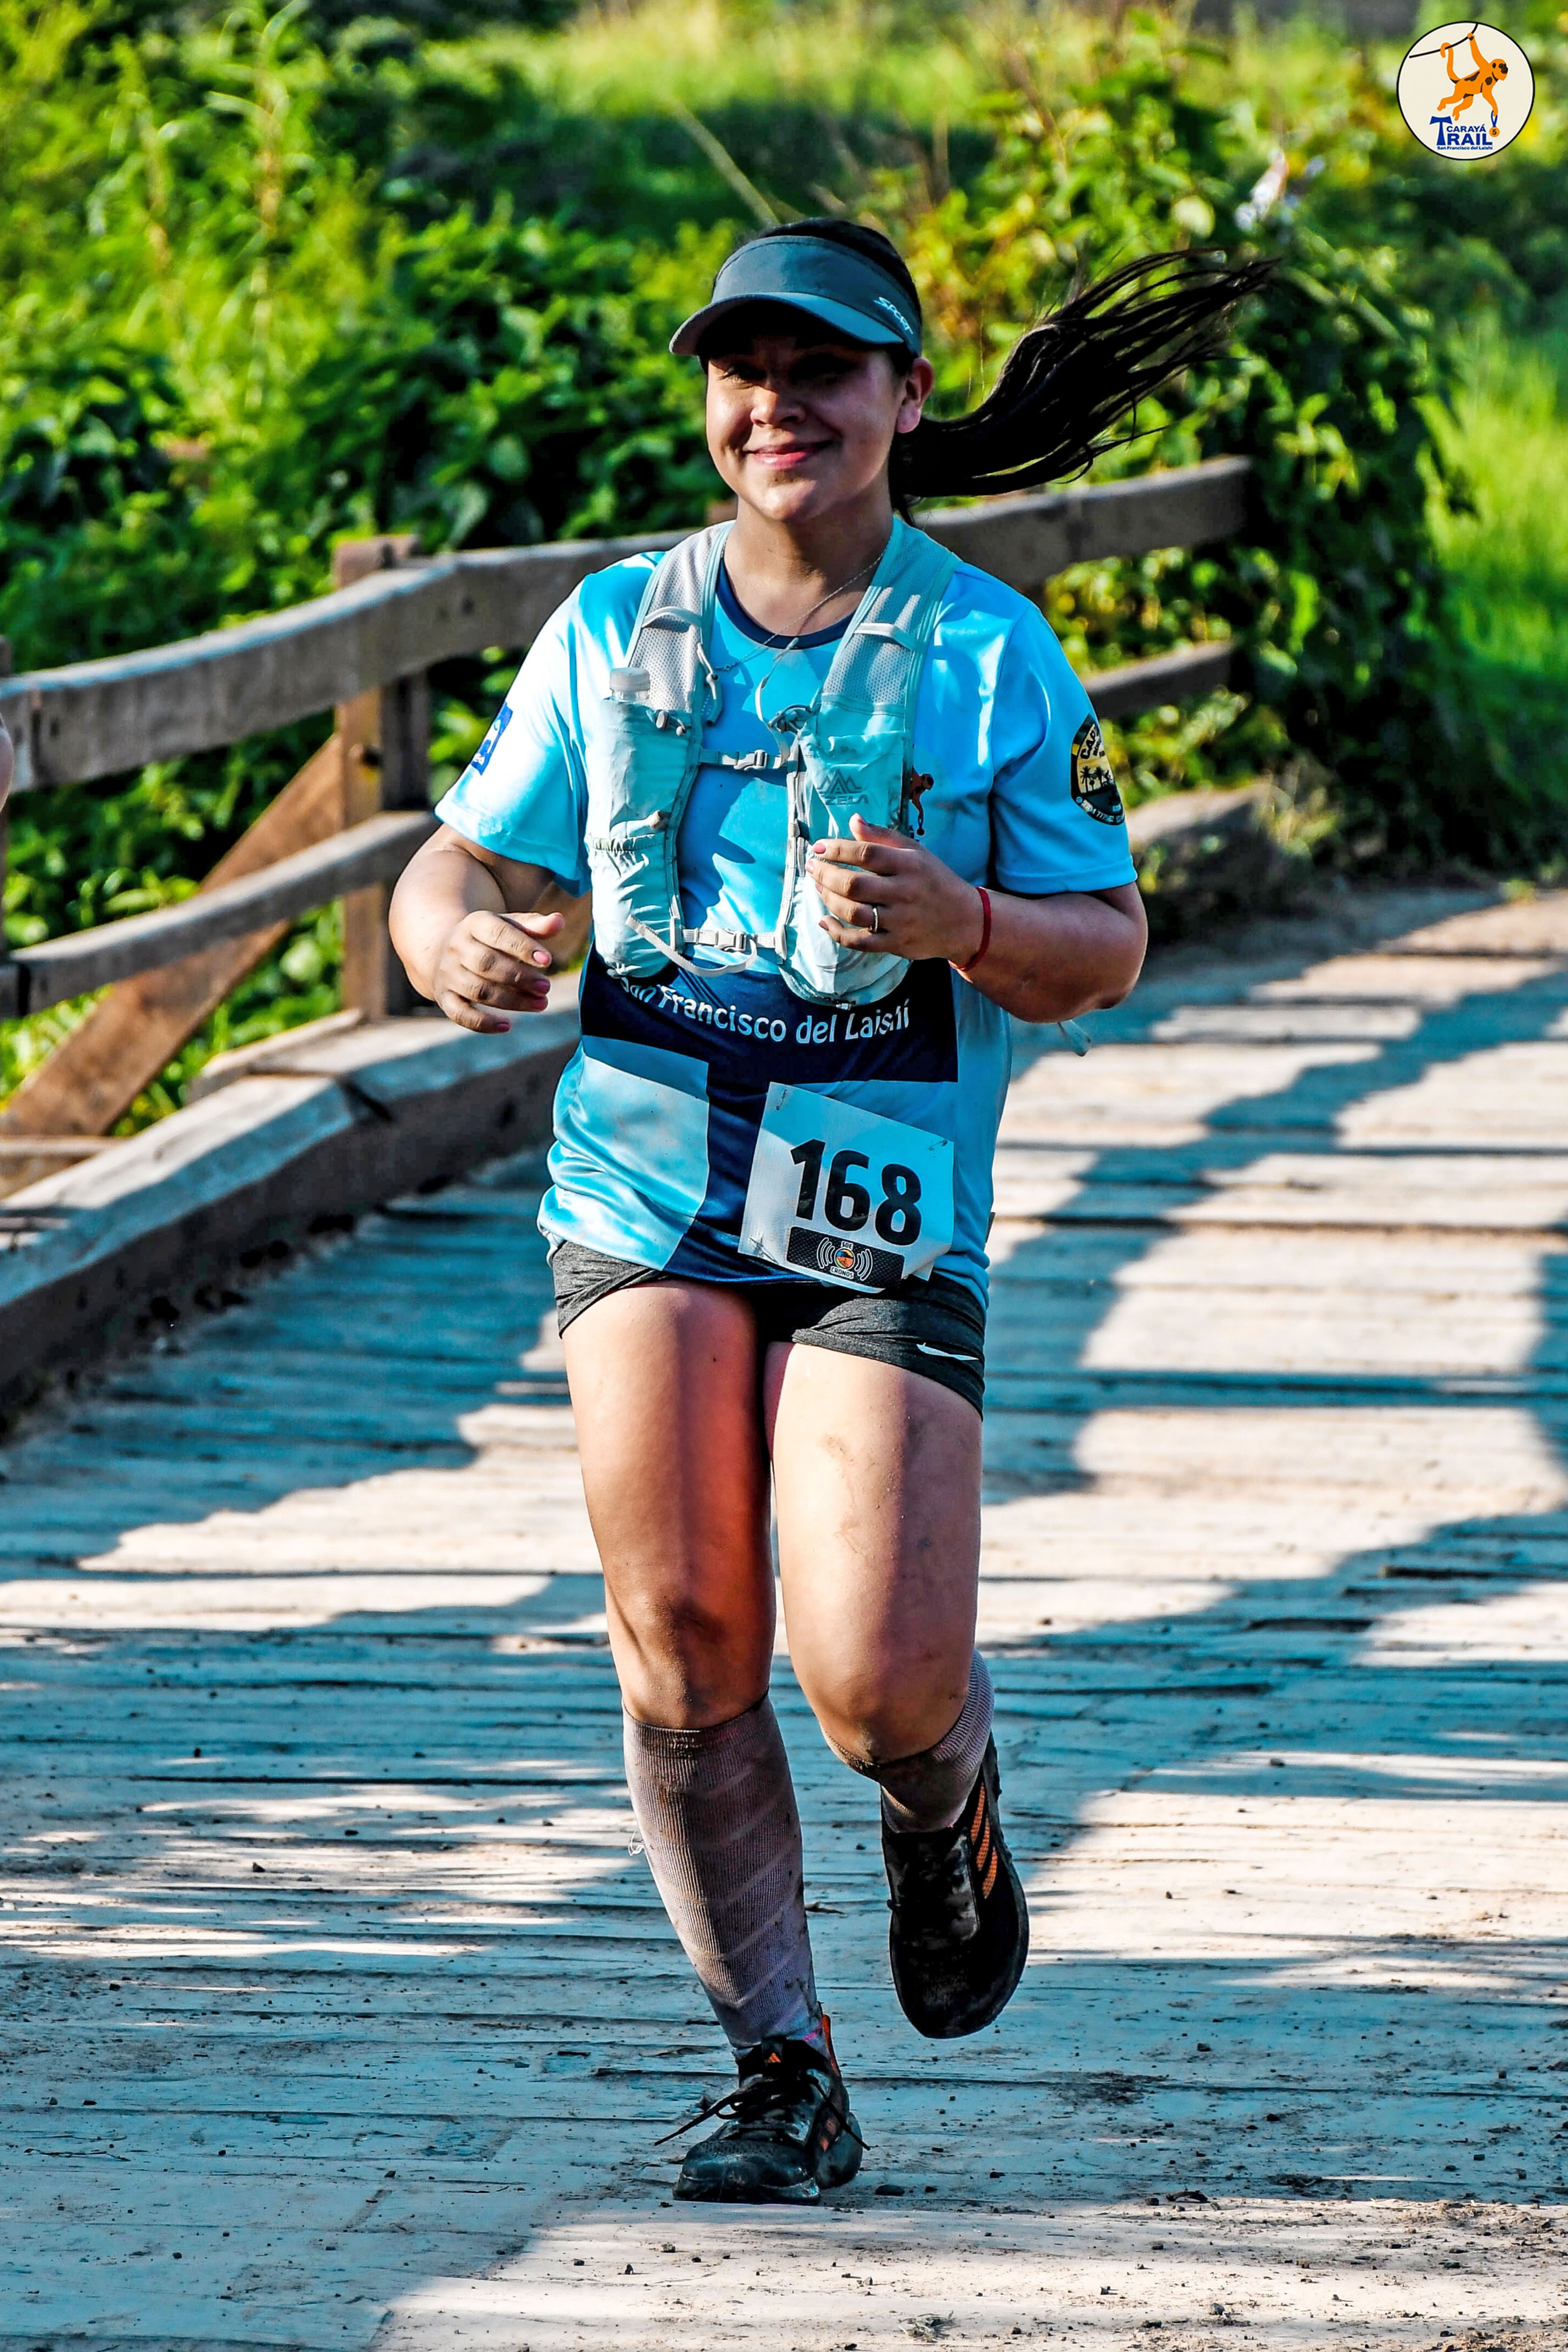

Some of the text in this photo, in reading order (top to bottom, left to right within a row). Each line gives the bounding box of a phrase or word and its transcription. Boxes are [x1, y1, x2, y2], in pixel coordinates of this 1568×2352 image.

[874, 296, 913, 334] SPORT
[656, 984, 786, 1042] Francisco
[796, 1014, 838, 1044] del
[790, 1138, 922, 1246] 168
[841, 1241, 853, 1250] SDE
[830, 1266, 855, 1279] CRONOS
